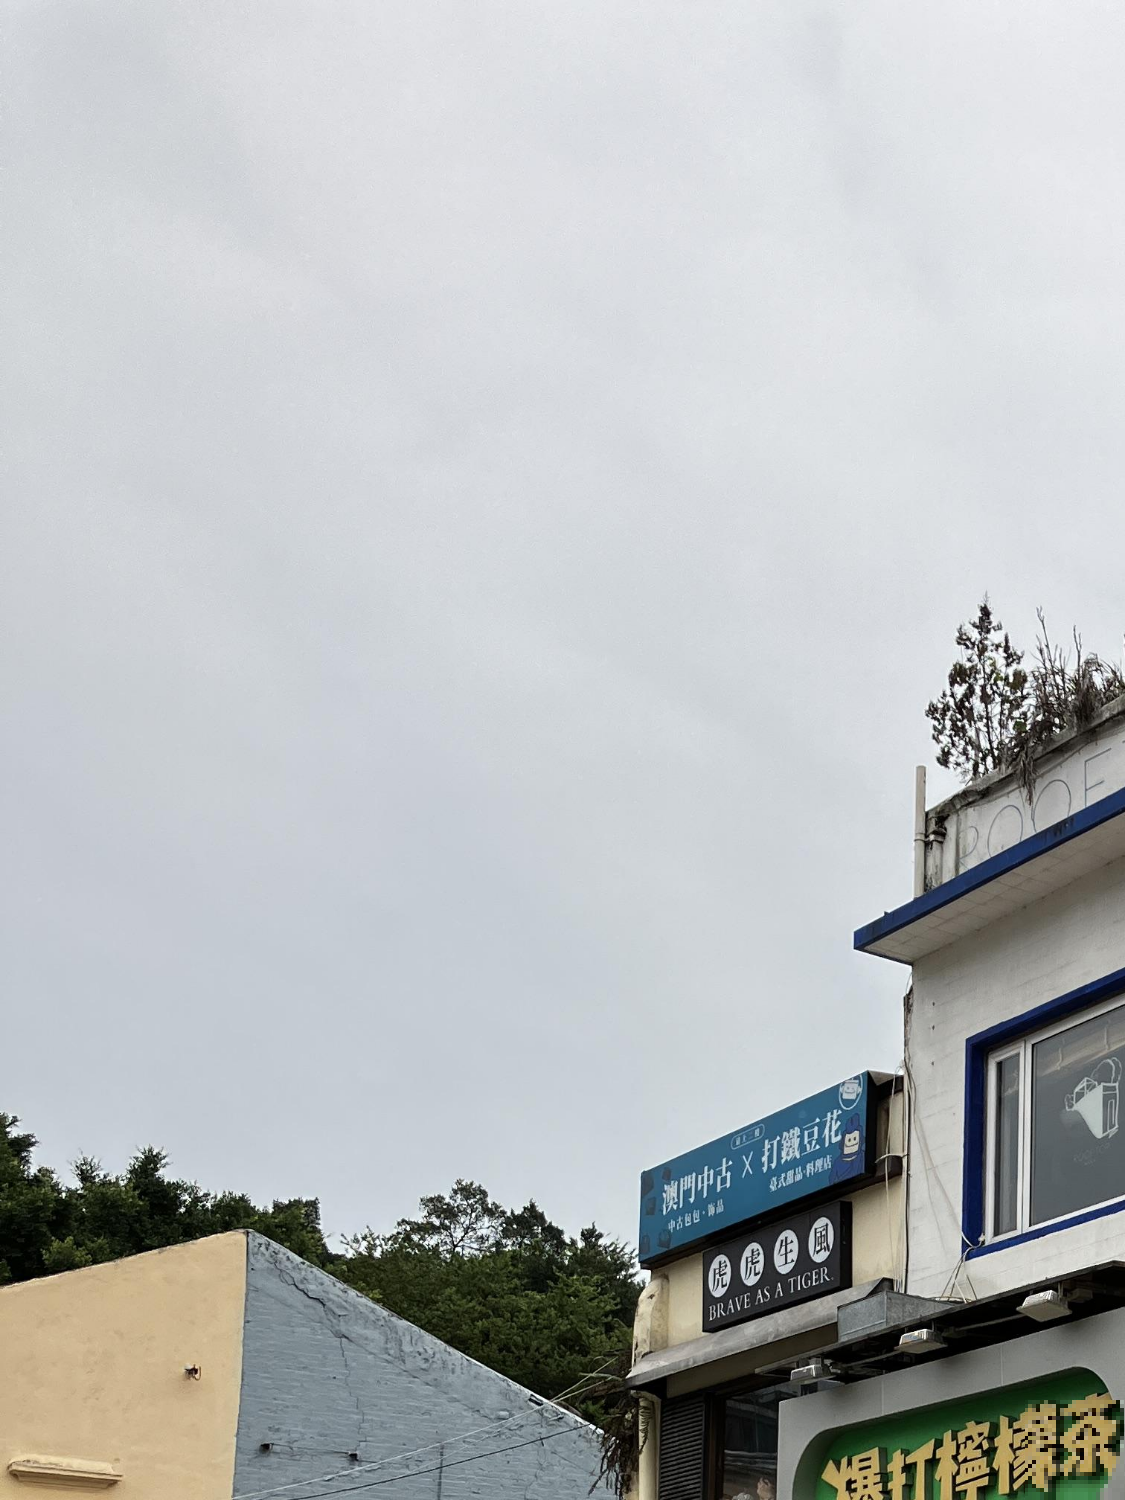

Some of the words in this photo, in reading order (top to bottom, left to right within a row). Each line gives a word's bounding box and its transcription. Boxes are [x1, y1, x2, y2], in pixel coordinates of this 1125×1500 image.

[661, 1157, 733, 1216] 澳門中古
[760, 1108, 843, 1174] 打鐵豆花
[711, 1222, 831, 1293] 虎虎生風
[708, 1293, 751, 1322] BRAVE
[755, 1286, 771, 1305] AS
[774, 1282, 784, 1299] A
